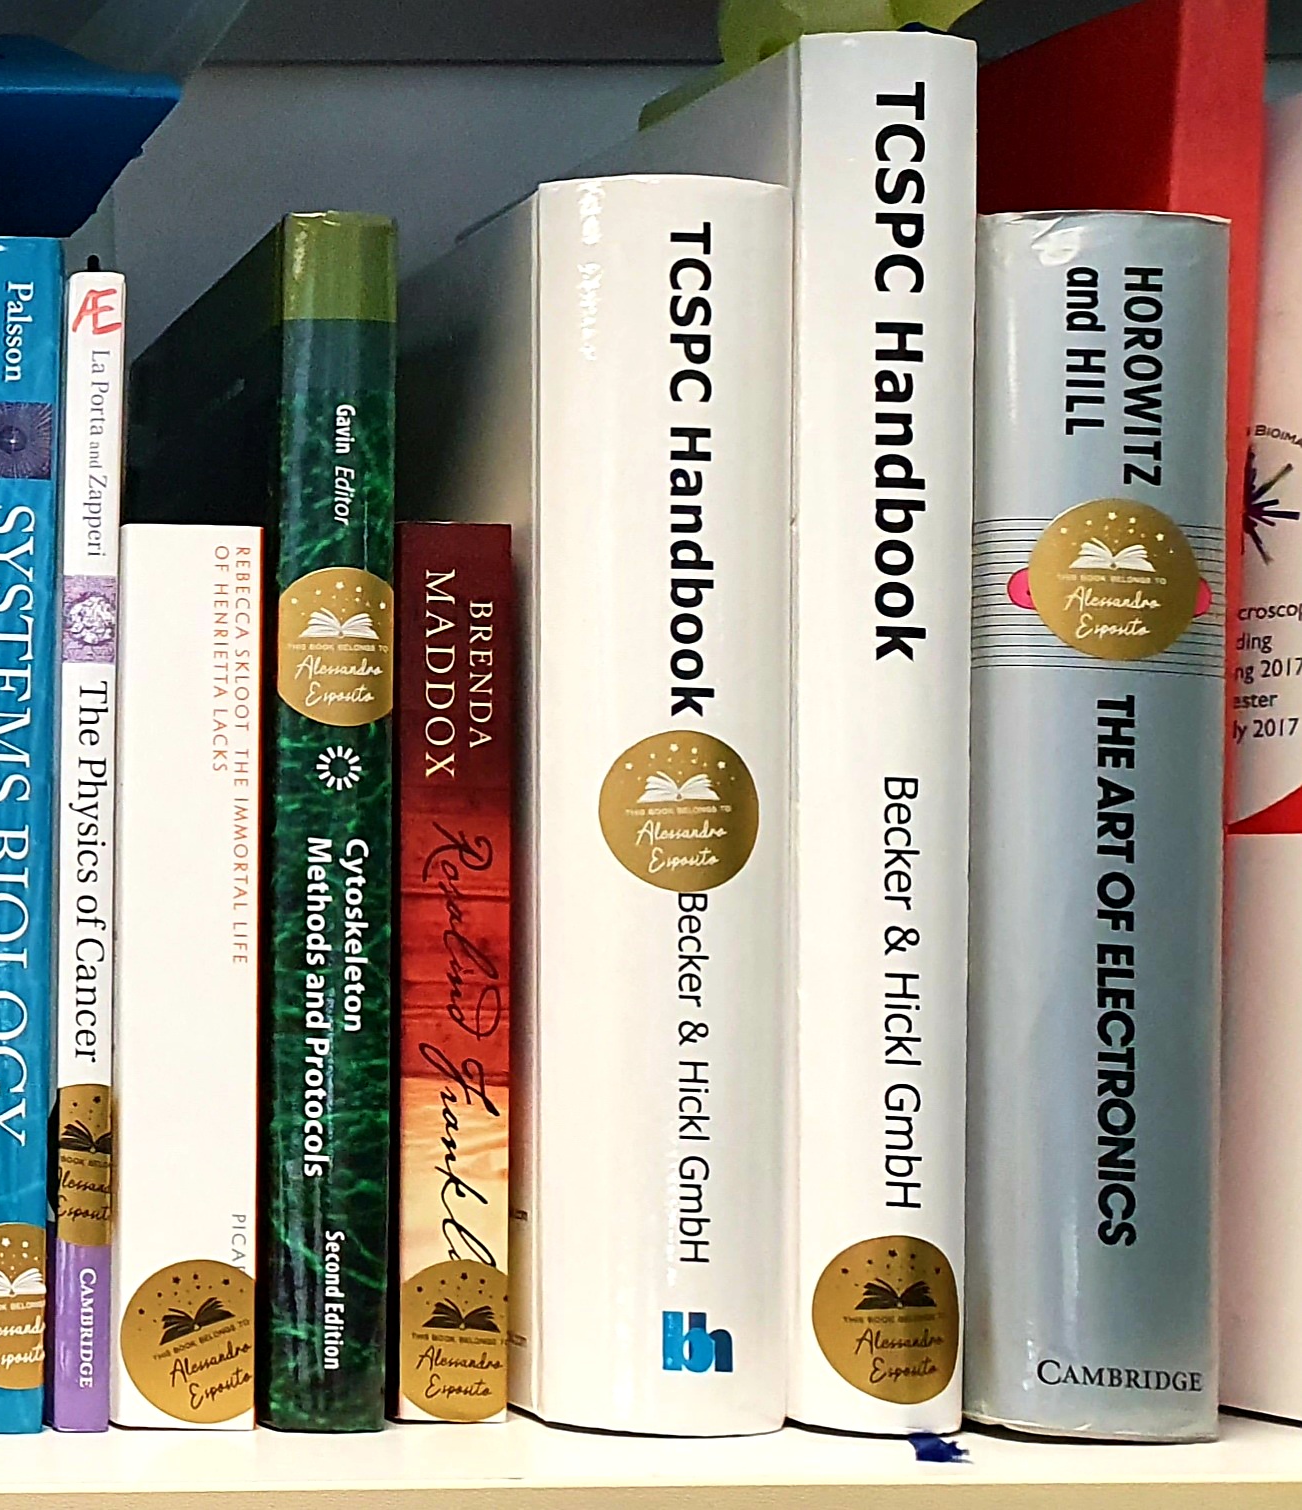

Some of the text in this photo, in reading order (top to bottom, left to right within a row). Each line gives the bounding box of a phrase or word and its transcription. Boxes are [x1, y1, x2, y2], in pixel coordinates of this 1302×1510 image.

[4, 282, 34, 382] Palsson
[874, 80, 927, 662] TCSPC Handbook
[1066, 266, 1106, 435] and HILL
[1123, 266, 1163, 488] HOROWITZ
[82, 349, 109, 558] La Porta and Zapperi
[335, 404, 355, 526] Gavin Editor
[212, 546, 230, 773] OF HENRIETTA LACKS
[424, 567, 456, 778] MADDOX
[469, 600, 493, 749] BRENDA
[1064, 585, 1161, 612] Alessandro
[232, 546, 251, 964] REBECCA SKLOOT THE IMMORTAL LIFE
[1251, 718, 1298, 741] 2017
[677, 891, 710, 1264] Becker & Hickl GmbH
[79, 1267, 95, 1388] CAMBRIDGE
[321, 1229, 343, 1372] Second Edition
[1037, 1359, 1202, 1392] CAMBRIDGE
